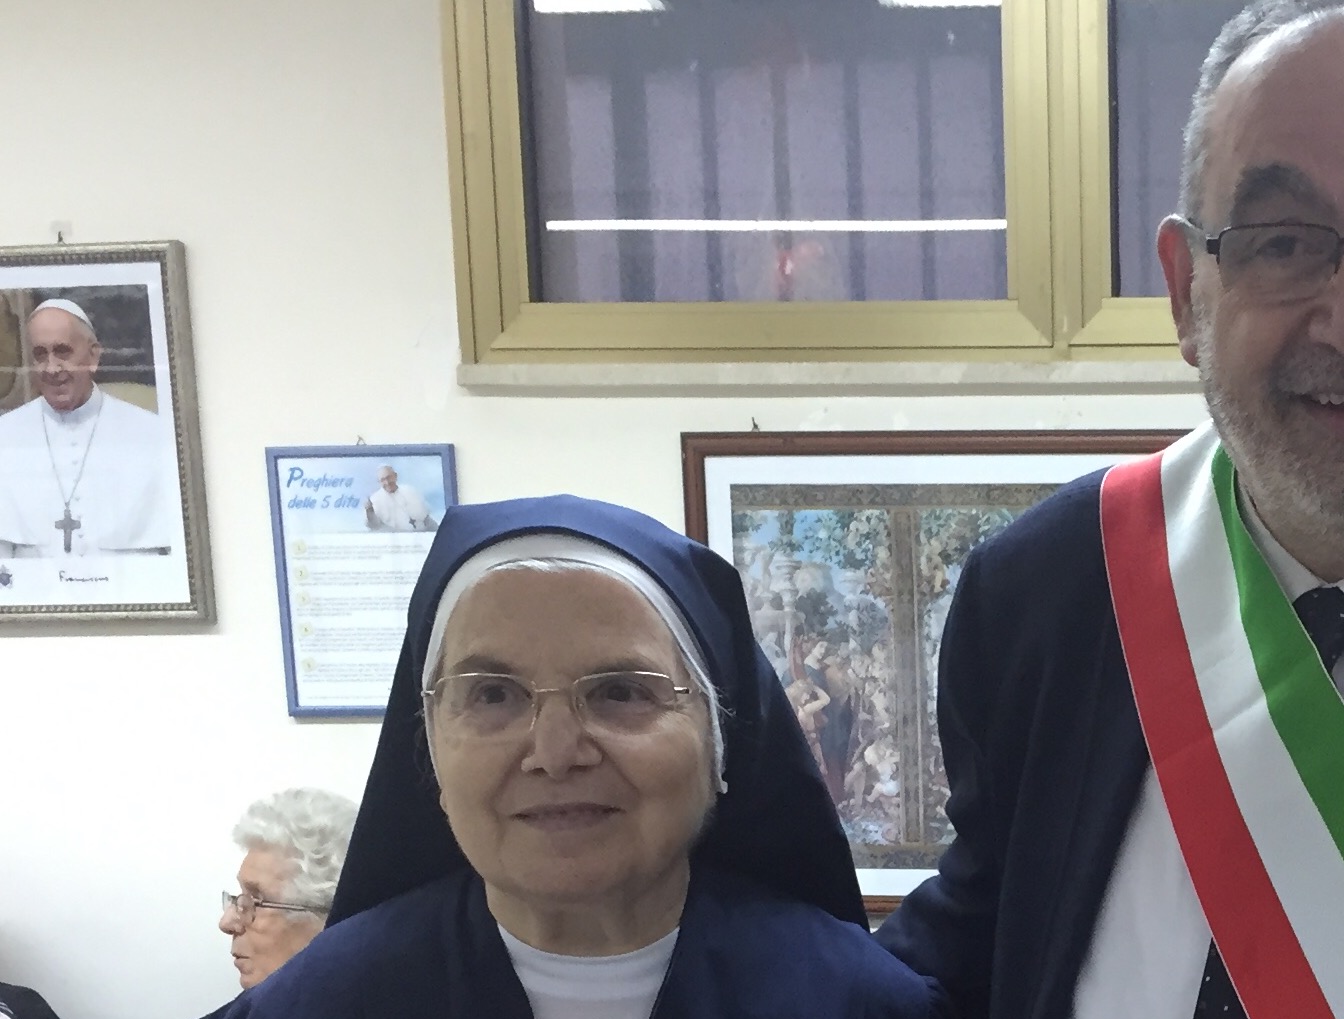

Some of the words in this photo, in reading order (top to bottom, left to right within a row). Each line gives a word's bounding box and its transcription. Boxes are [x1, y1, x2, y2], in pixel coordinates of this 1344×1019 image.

[286, 466, 354, 492] Preghiera
[287, 494, 317, 509] delle
[320, 494, 332, 509] 5
[333, 493, 361, 509] dita
